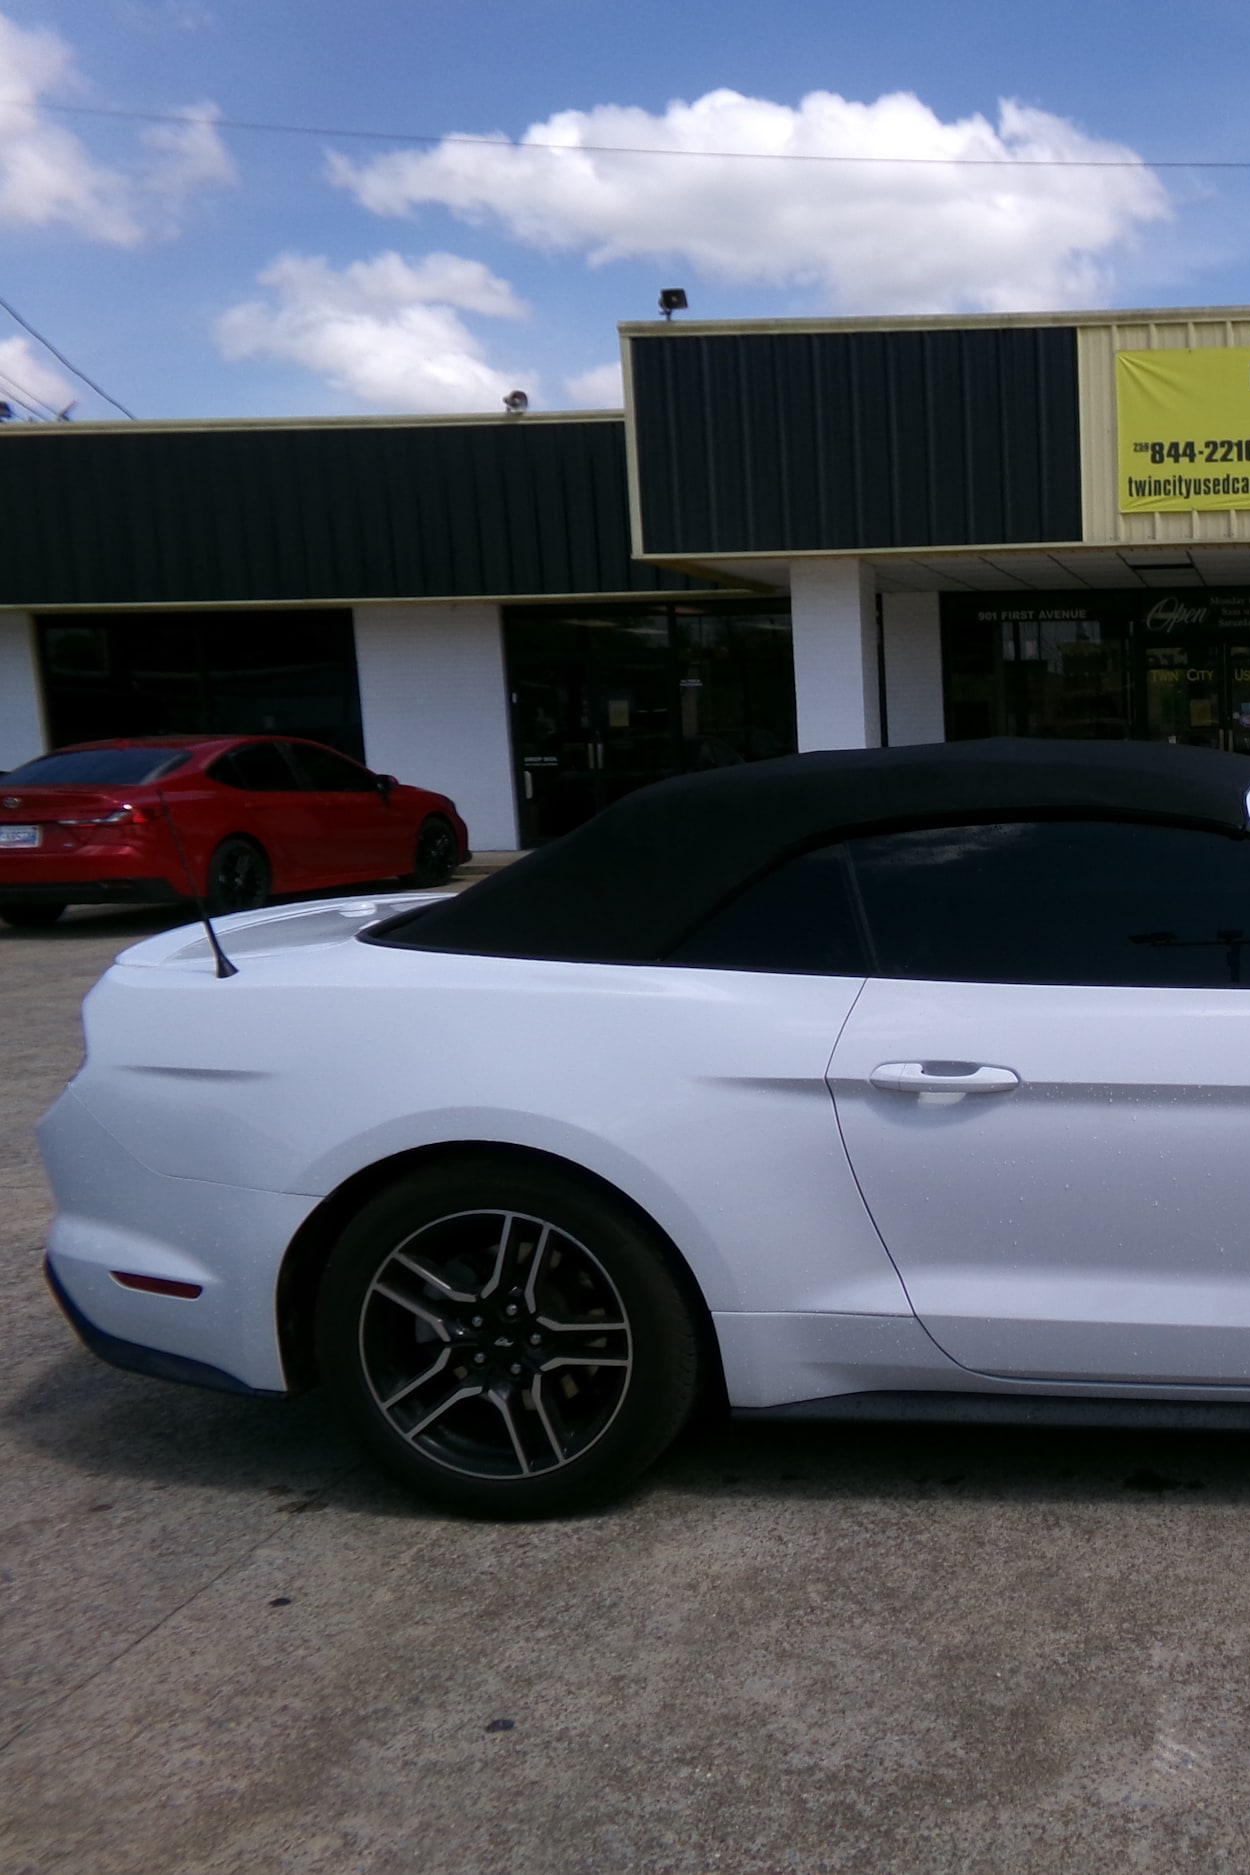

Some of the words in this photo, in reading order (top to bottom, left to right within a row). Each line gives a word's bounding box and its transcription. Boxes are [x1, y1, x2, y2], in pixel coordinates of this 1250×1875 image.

[977, 610, 998, 622] 901
[1000, 610, 1035, 621] FIRST
[1038, 609, 1088, 620] AVENUE
[1146, 596, 1209, 633] Open
[1151, 669, 1179, 682] TWIN
[1186, 668, 1214, 682] CITY
